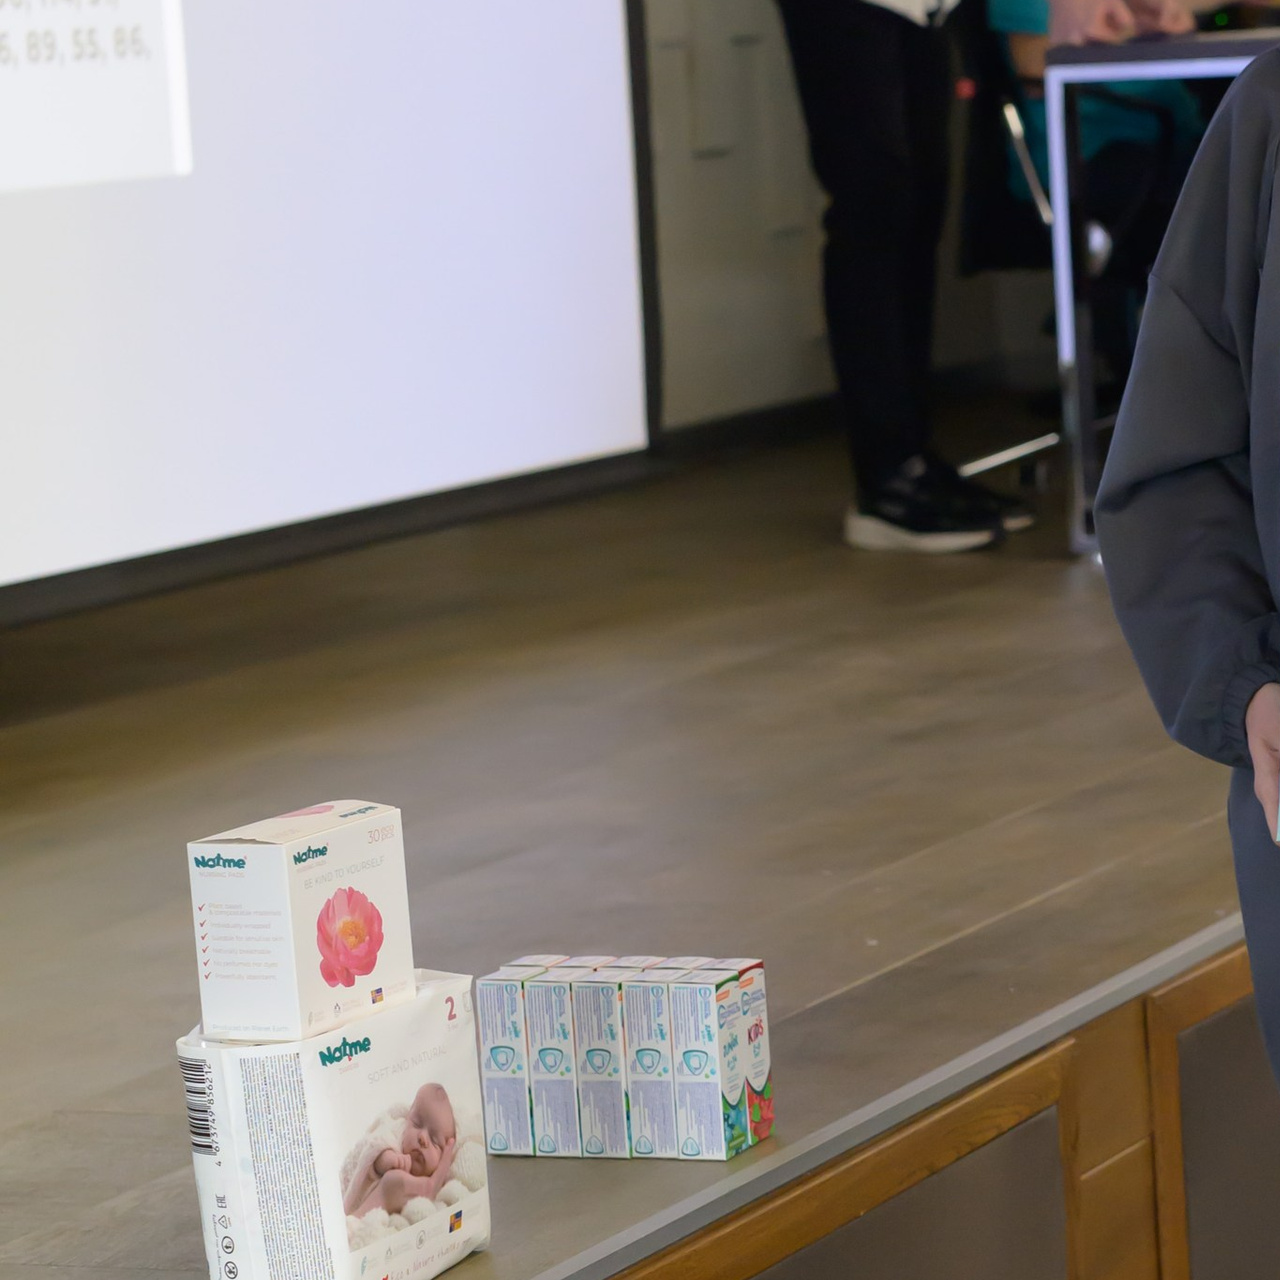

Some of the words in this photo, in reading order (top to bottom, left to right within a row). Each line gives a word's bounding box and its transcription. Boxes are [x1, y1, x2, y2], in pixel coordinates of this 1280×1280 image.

[367, 829, 380, 844] 30
[334, 868, 345, 879] TO
[346, 856, 385, 874] YOURSELF
[445, 996, 456, 1021] 2
[203, 1063, 214, 1105] 856212
[367, 1066, 391, 1084] SOFT
